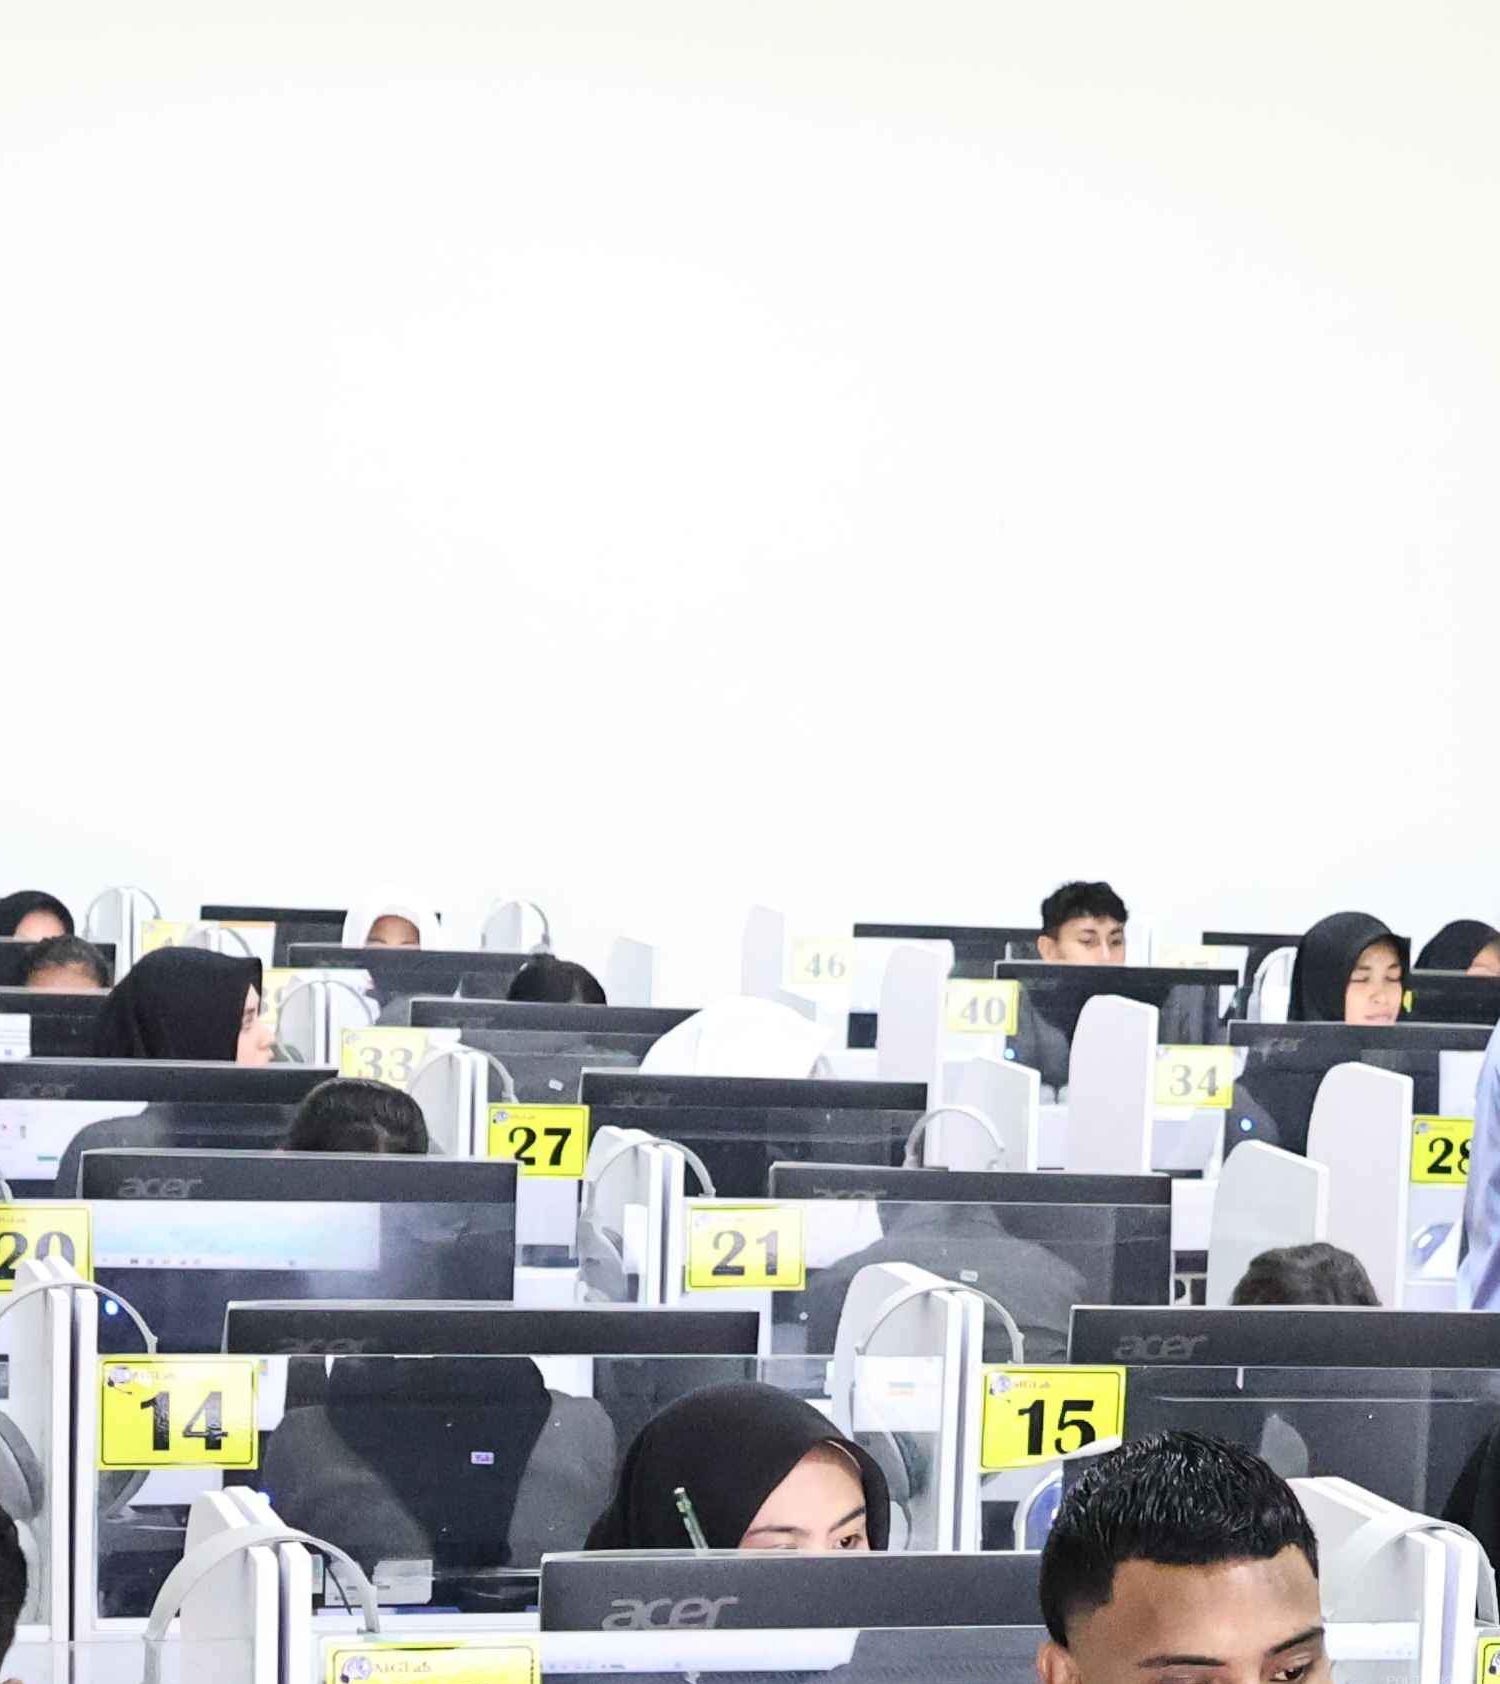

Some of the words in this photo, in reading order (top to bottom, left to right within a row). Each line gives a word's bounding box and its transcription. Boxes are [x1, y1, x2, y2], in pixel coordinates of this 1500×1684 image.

[804, 951, 846, 979] 46
[959, 997, 1007, 1026] 40
[356, 1046, 413, 1081] 33
[1168, 1063, 1220, 1098] 34
[507, 1126, 572, 1167] 27
[1427, 1136, 1472, 1176] 28
[118, 1177, 203, 1199] acer
[711, 1229, 780, 1276] 21
[1111, 1332, 1209, 1360] acer
[139, 1390, 229, 1451] 14
[1017, 1399, 1097, 1456] 15
[602, 1595, 739, 1631] acer
